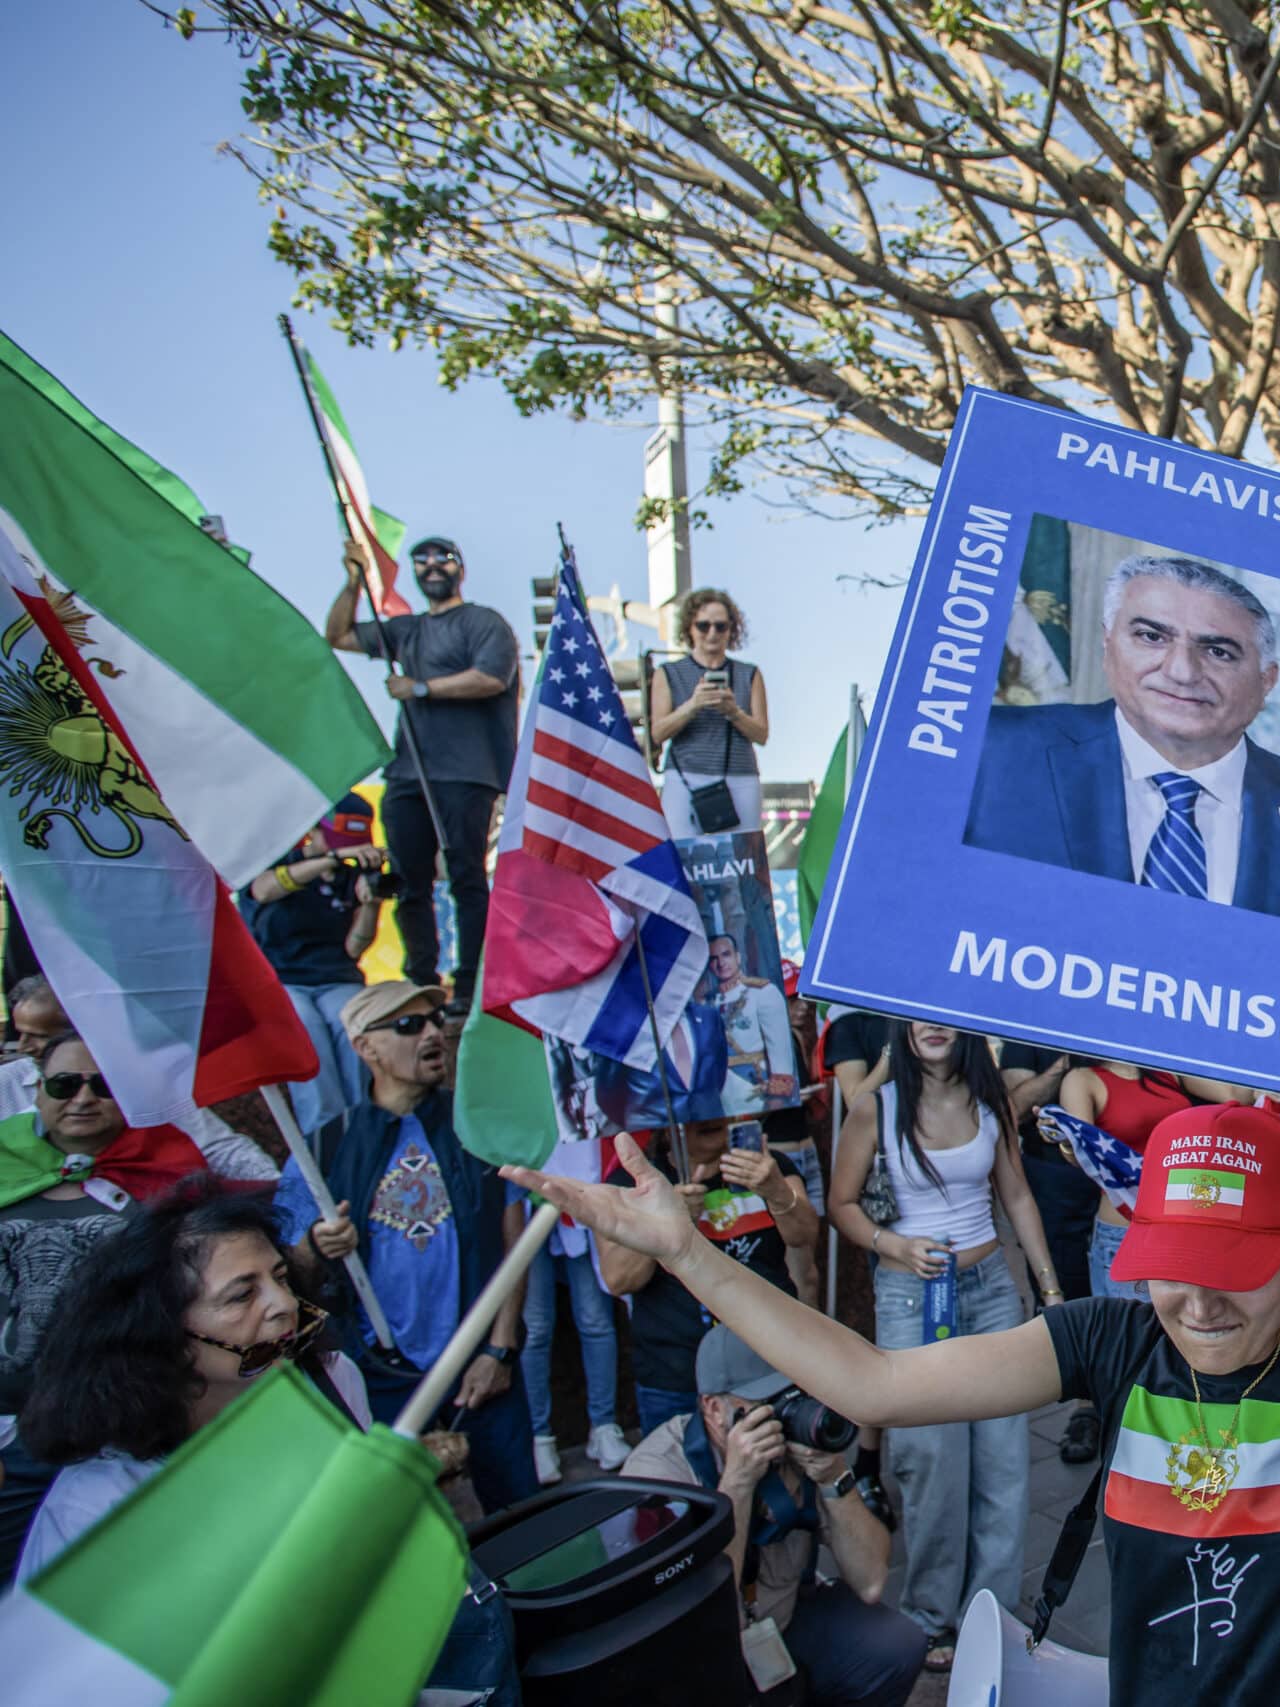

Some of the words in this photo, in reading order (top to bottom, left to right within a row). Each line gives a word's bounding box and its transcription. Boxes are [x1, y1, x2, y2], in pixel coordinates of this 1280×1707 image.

[908, 504, 1013, 758] PATRIOTISM
[1170, 1135, 1212, 1151] MAKE
[1216, 1136, 1256, 1156] IRAN
[1162, 1151, 1209, 1168] GREAT
[1211, 1152, 1262, 1175] AGAIN
[655, 1553, 694, 1584] SONY
